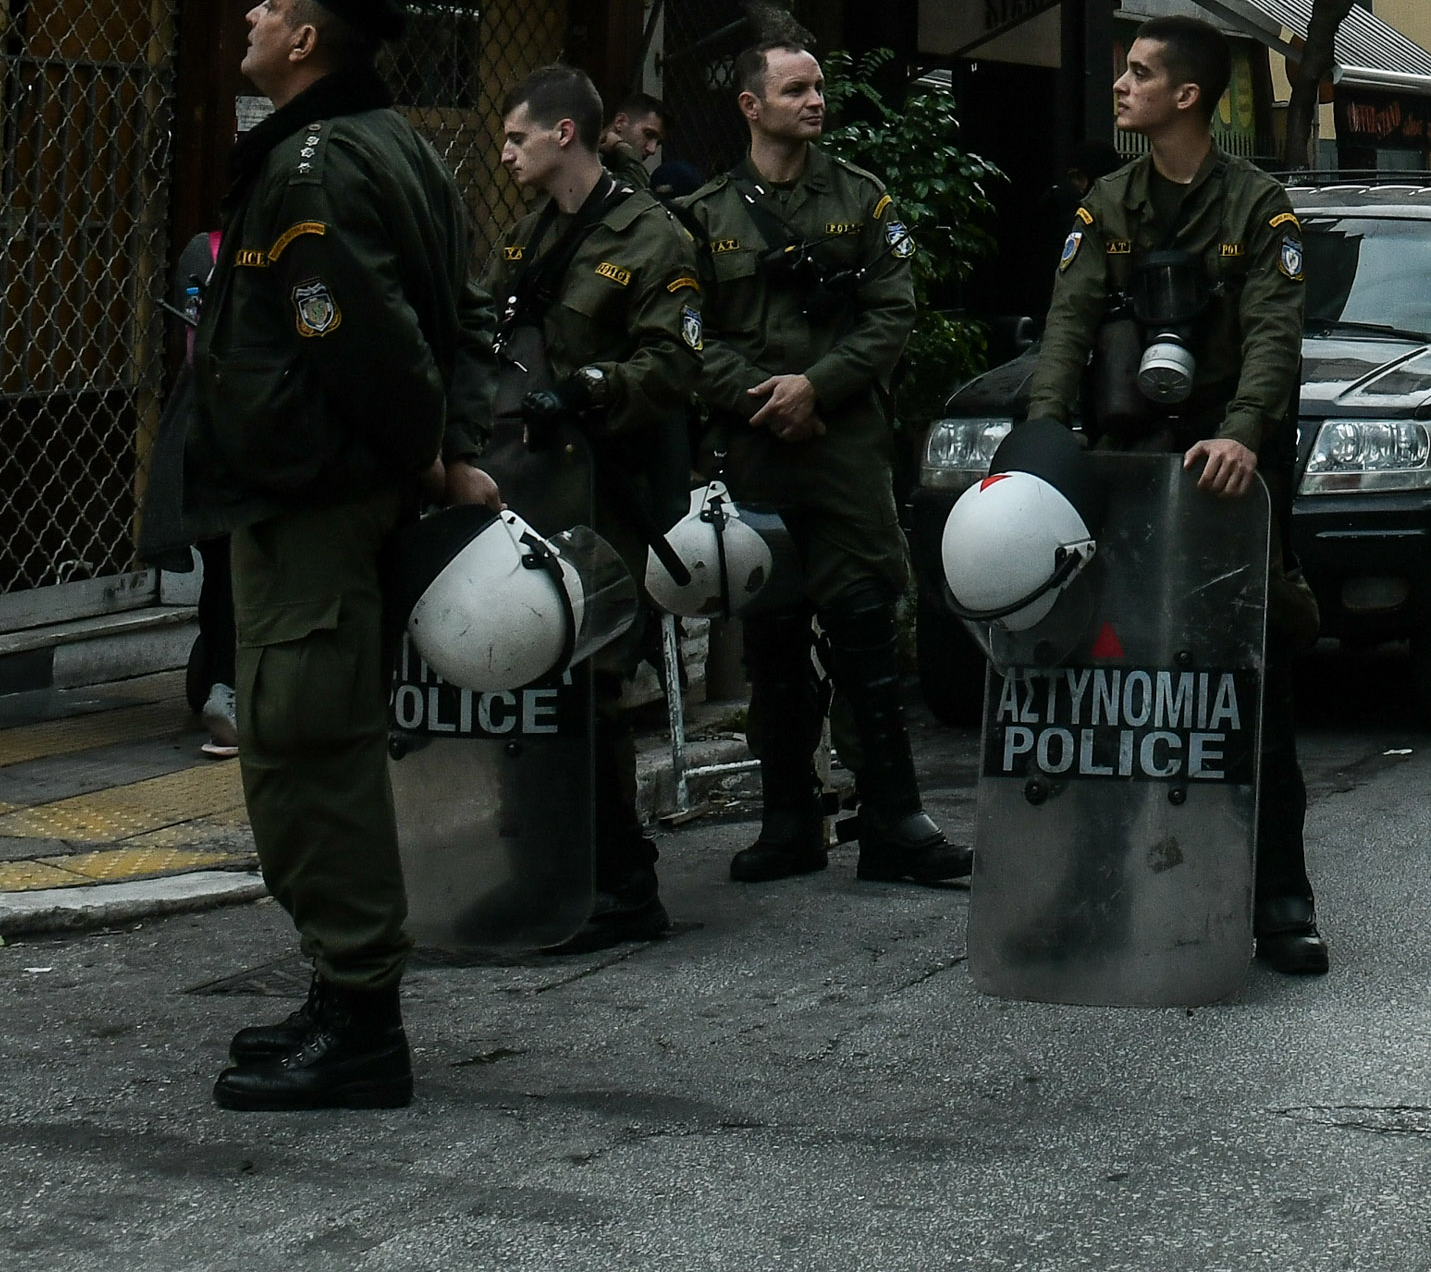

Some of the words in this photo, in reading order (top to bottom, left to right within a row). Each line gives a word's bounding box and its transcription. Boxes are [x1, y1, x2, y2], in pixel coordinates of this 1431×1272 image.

[390, 684, 558, 734] OLICE
[996, 667, 1241, 730] ΑΣΤΥΝΟΜΙΑ
[1002, 726, 1226, 779] POLICE
